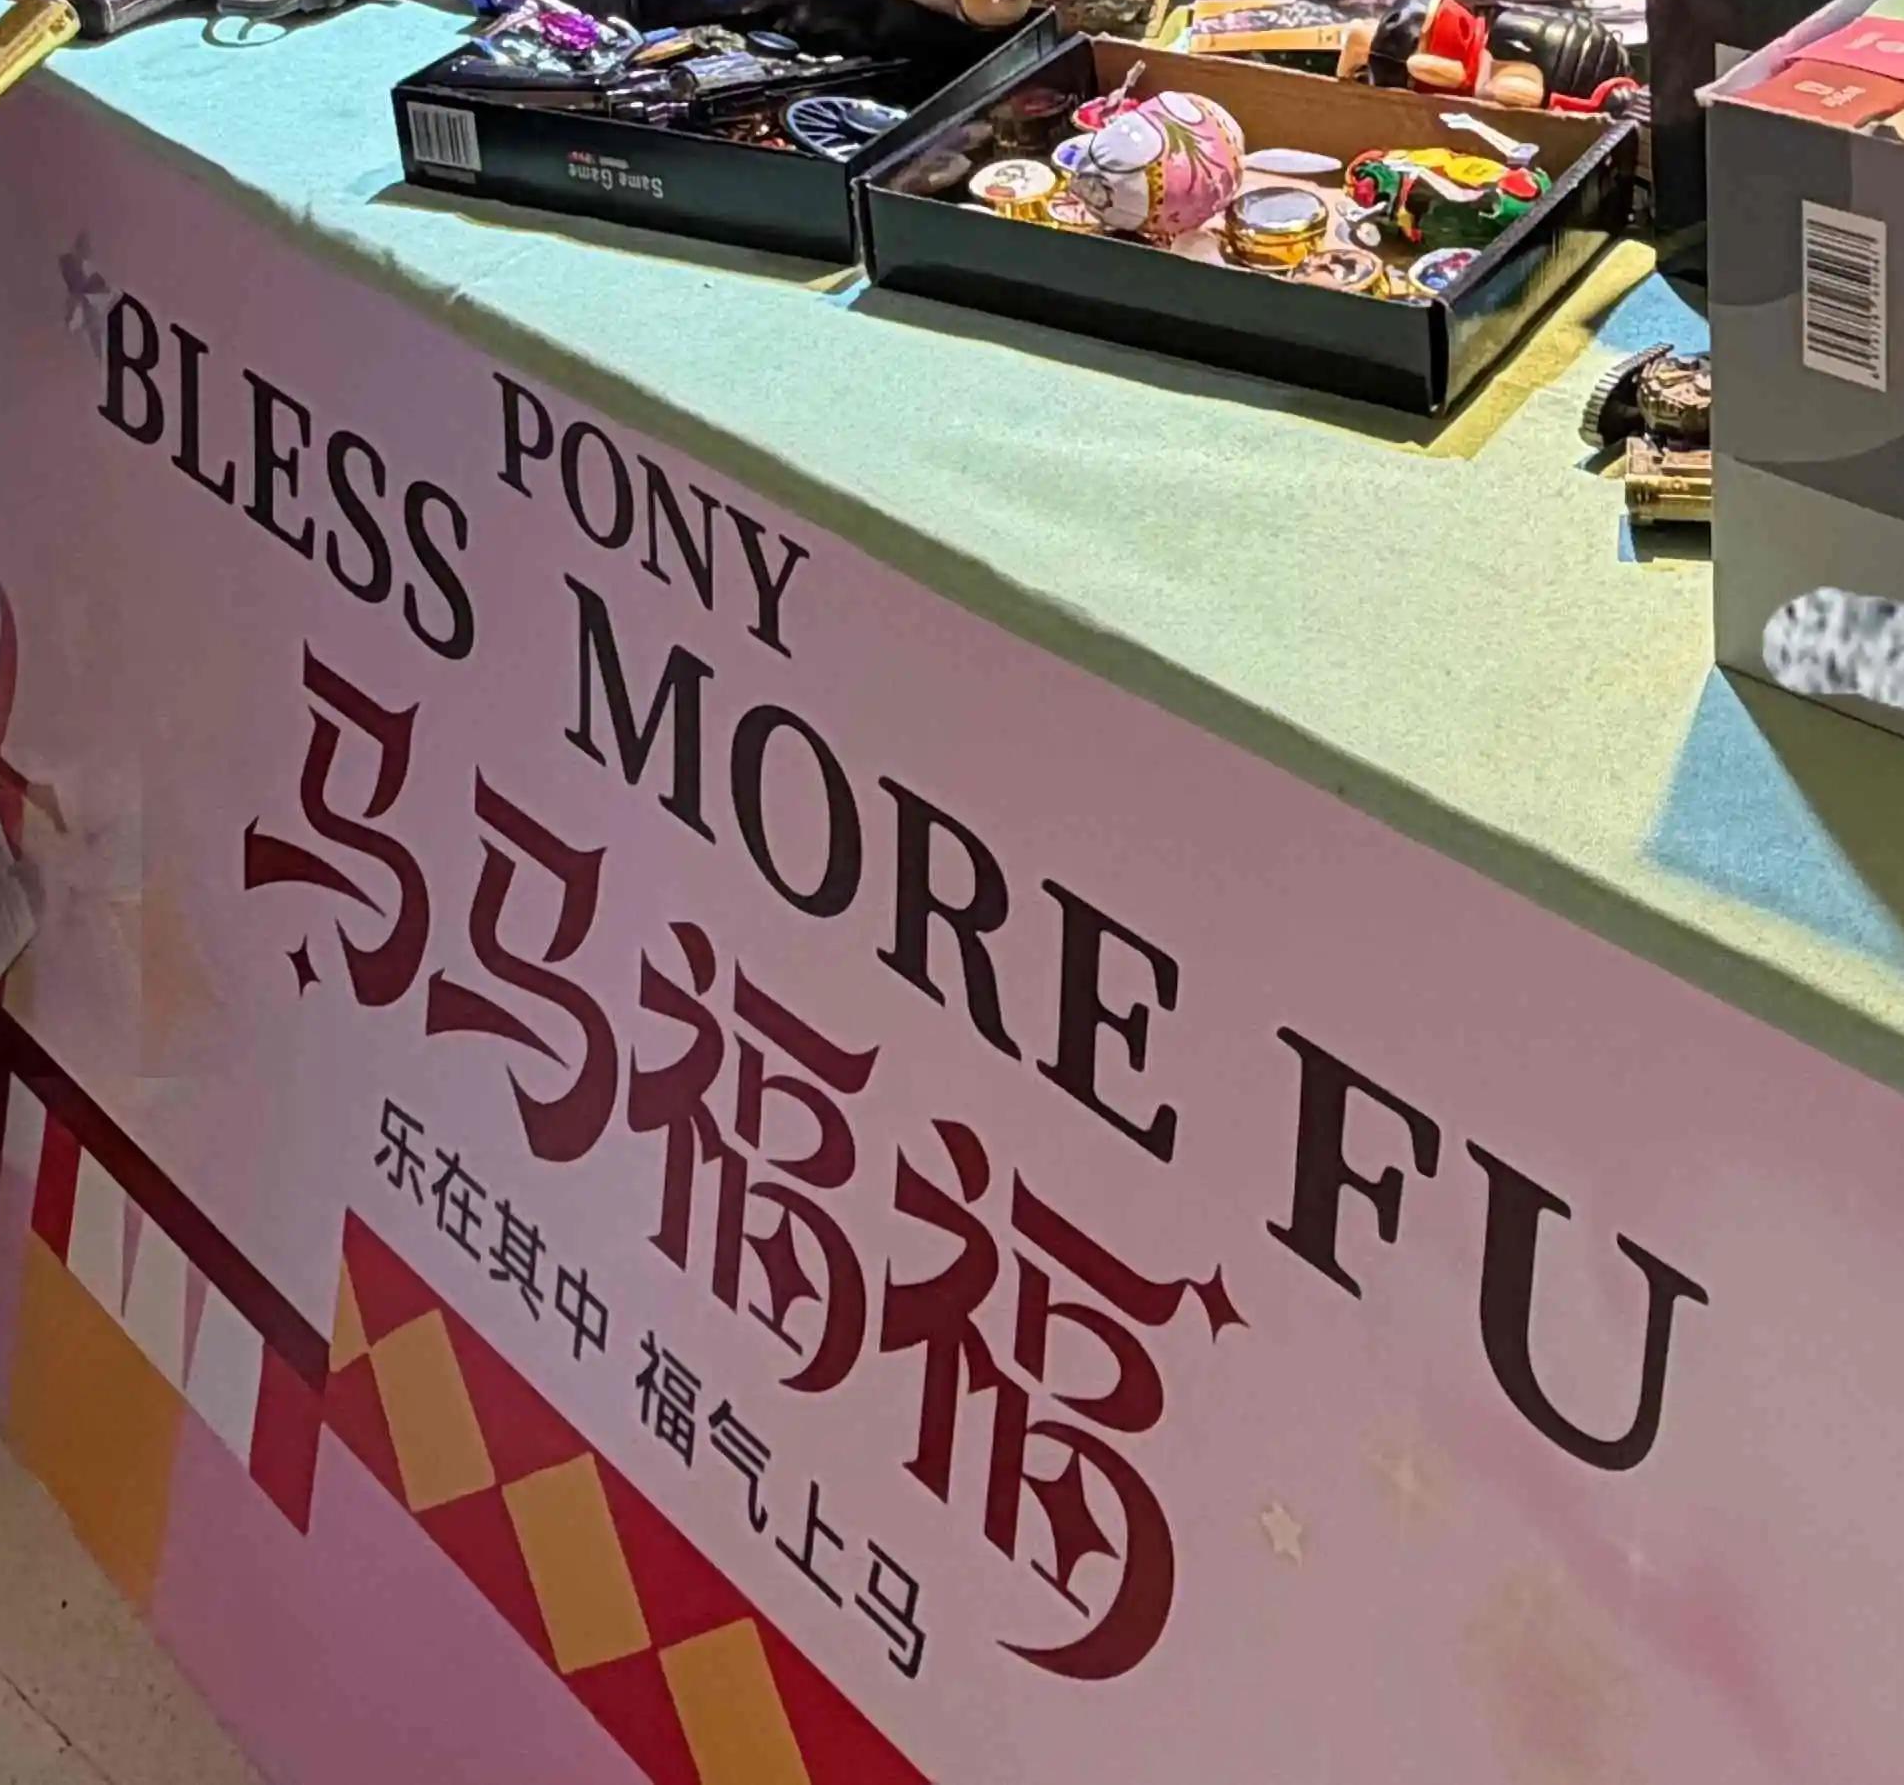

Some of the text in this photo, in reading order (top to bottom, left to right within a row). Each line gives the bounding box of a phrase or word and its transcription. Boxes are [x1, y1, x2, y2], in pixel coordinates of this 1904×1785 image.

[97, 289, 1709, 1472] BLESS MORE FU
[493, 372, 810, 658] PONY
[243, 638, 1191, 1682] 马马福福
[373, 1097, 928, 1681] 乐在其中 福气上马
